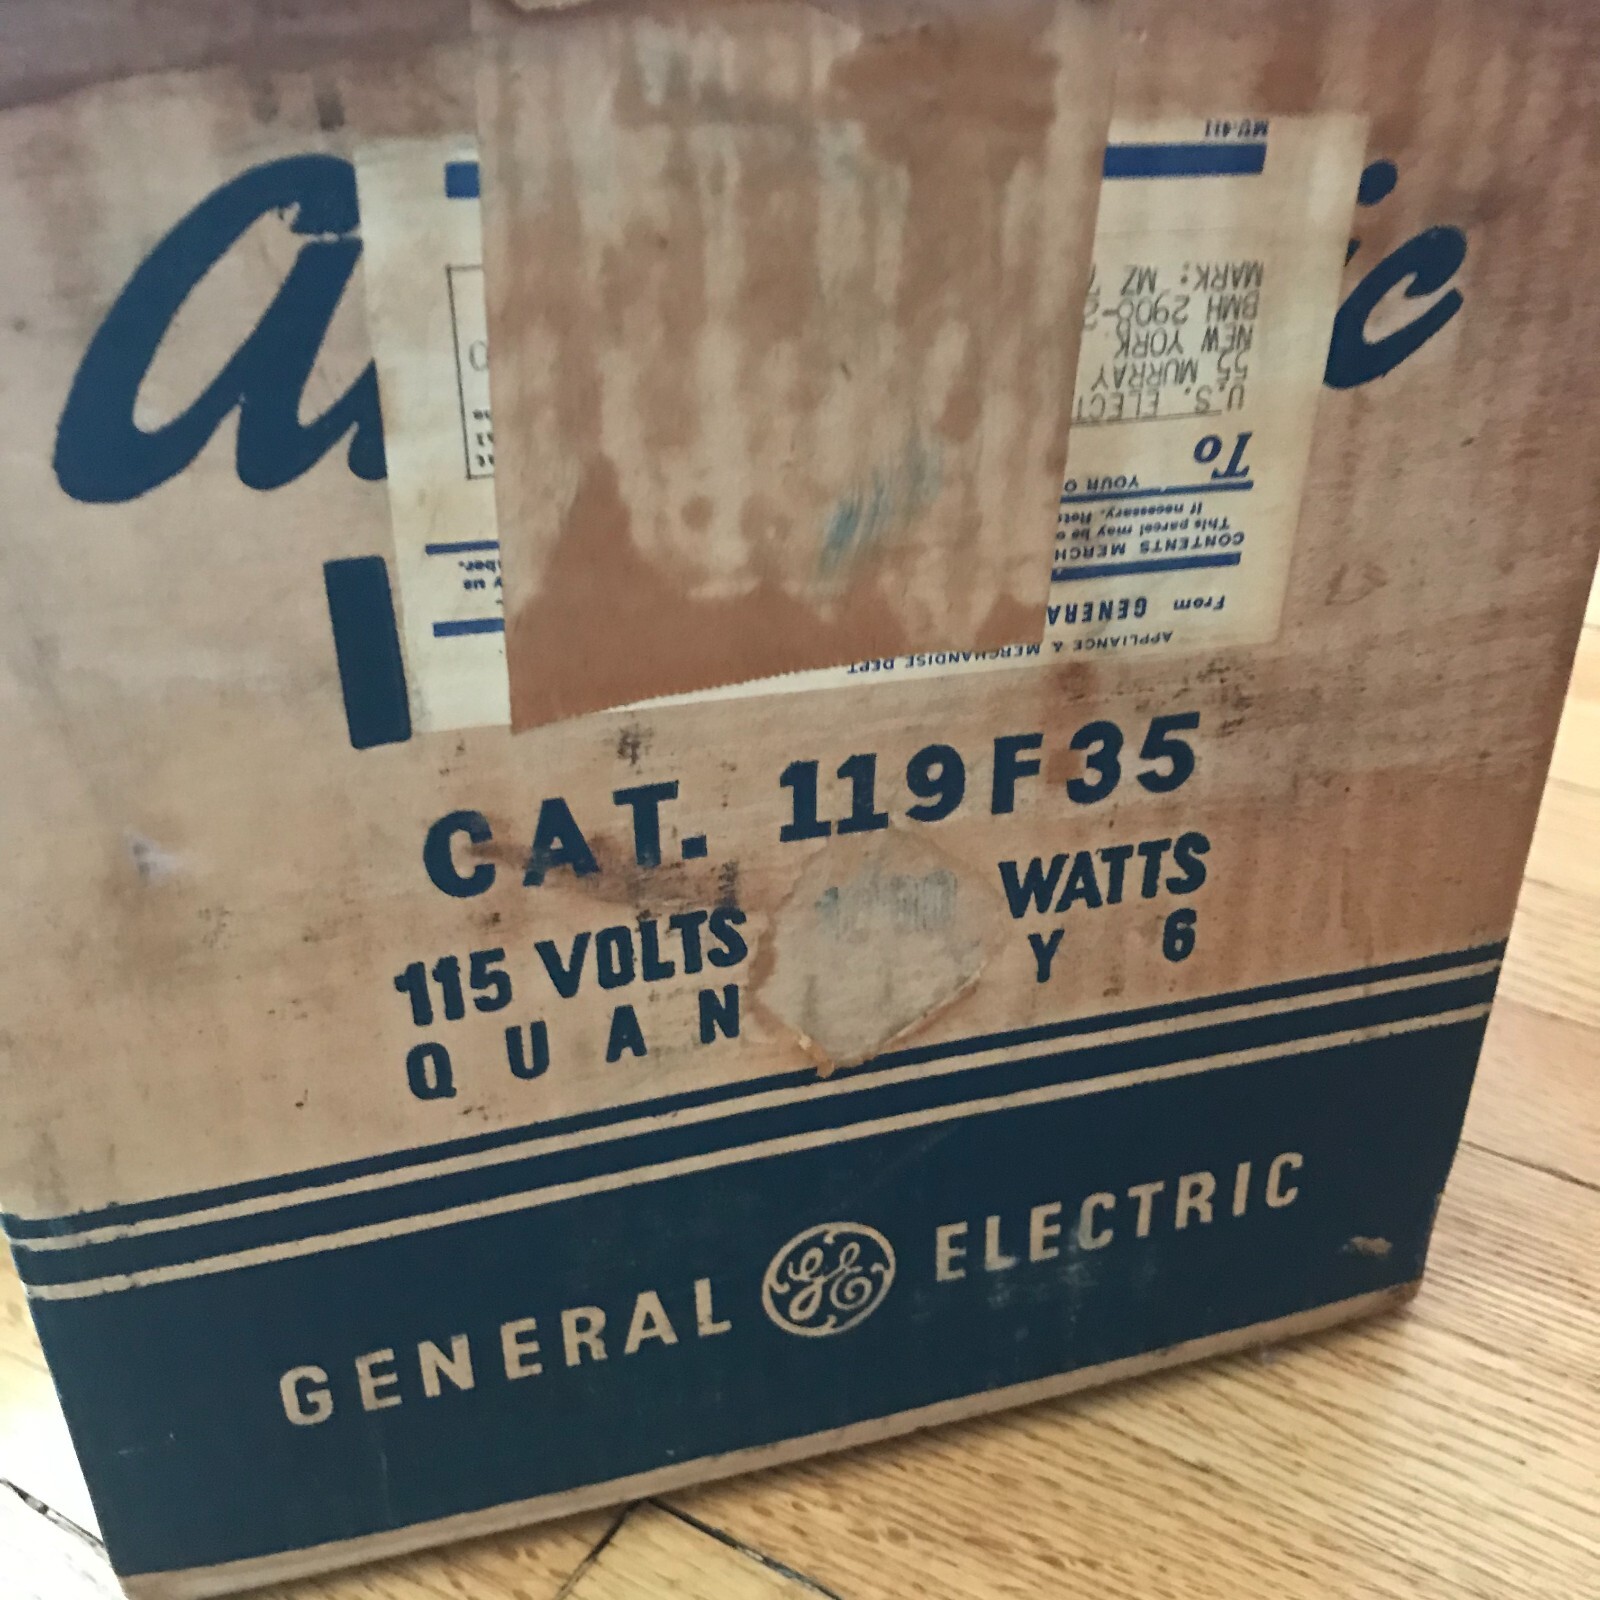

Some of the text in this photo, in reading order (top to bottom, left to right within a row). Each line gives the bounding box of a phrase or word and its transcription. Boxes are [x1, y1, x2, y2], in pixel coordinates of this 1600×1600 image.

[1113, 323, 1253, 359] NEW YORK
[1091, 350, 1248, 392] 55 MURRAY
[1193, 431, 1252, 480] To
[1097, 524, 1133, 538] may
[1139, 518, 1189, 537] parcel
[1194, 516, 1230, 531] This
[1139, 531, 1246, 554] CONTENTS
[1047, 595, 1226, 626] From GENERA
[1052, 641, 1064, 653] &
[1072, 630, 1174, 650] APPLIANCE
[422, 779, 708, 899] CAT.
[997, 831, 1211, 919] WATTS
[1162, 908, 1198, 962] 6
[394, 907, 748, 1027] 115 VOLTS
[278, 1277, 732, 1427] GENERAL
[935, 1151, 1303, 1282] ELECTRIC
